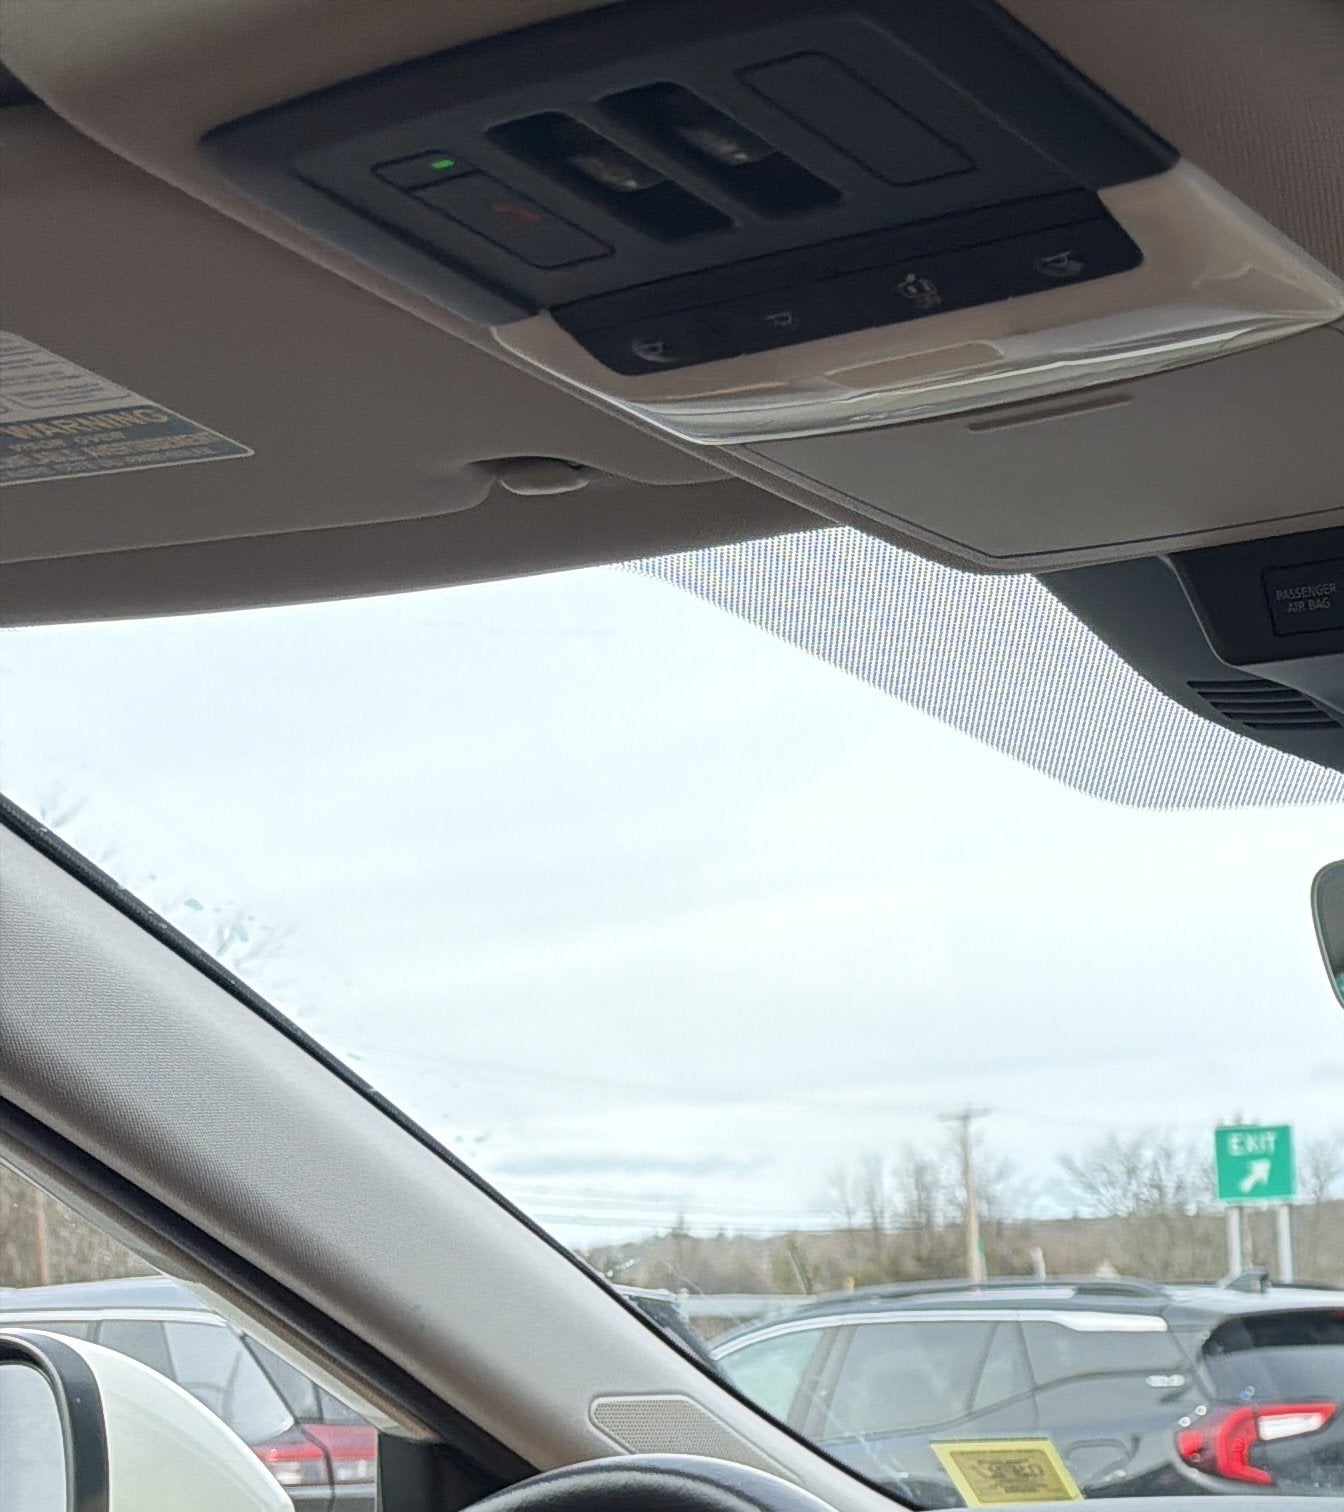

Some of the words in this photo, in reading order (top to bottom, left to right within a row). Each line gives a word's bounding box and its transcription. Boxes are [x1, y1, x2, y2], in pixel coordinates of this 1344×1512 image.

[1275, 583, 1337, 600] PASSENGER
[1288, 600, 1306, 613] AIR
[1309, 597, 1330, 610] BAG
[1228, 1131, 1276, 1156] EXIT
